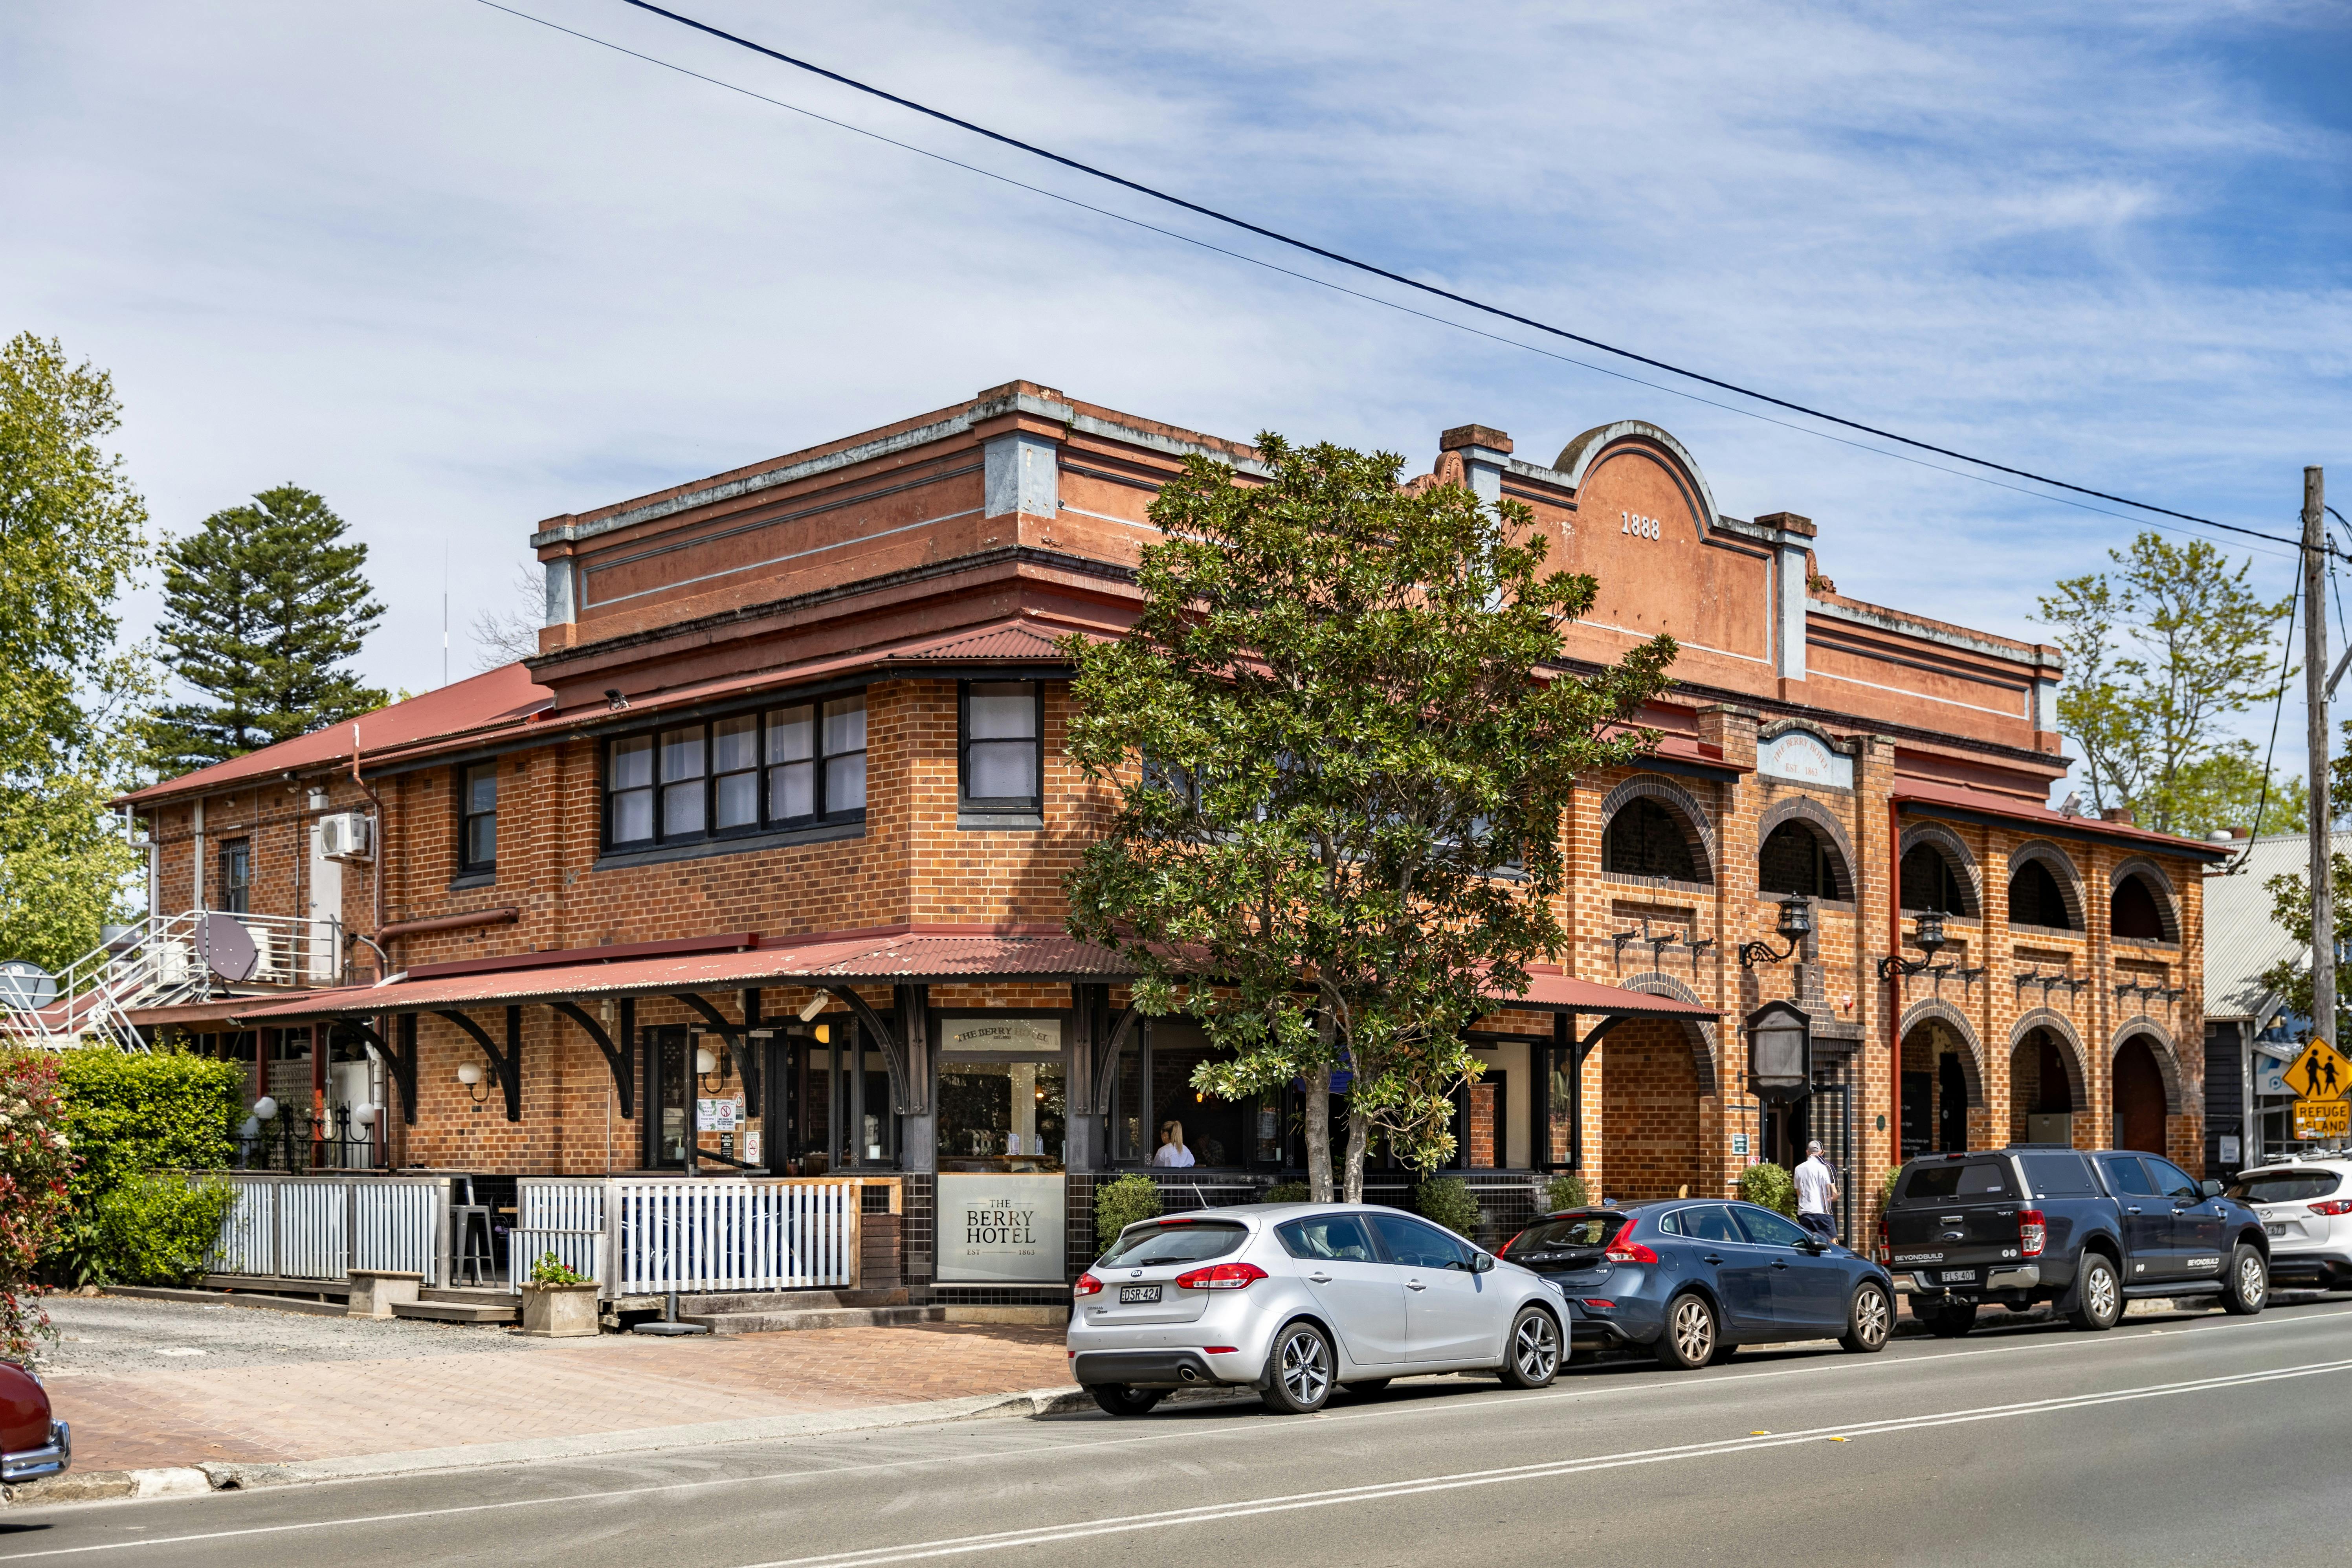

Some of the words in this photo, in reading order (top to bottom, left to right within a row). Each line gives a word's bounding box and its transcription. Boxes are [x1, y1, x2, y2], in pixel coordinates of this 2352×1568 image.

[1622, 511, 1660, 541] 1888
[1774, 744, 1785, 762] THE
[1786, 737, 1809, 748] BERRY
[1809, 743, 1827, 772] HOTEL
[1805, 767, 1818, 776] 1863
[956, 1030, 978, 1042] THE
[978, 1027, 1013, 1037] BERRY
[2300, 1106, 2347, 1117] REFUGE
[2301, 1121, 2346, 1132] SLAND
[967, 1210, 1034, 1226] BERRY
[967, 1228, 1036, 1243] HOTEL
[1894, 1253, 1943, 1261] BEYONDBUILD
[2187, 1258, 2220, 1266] BEYONDBUILD
